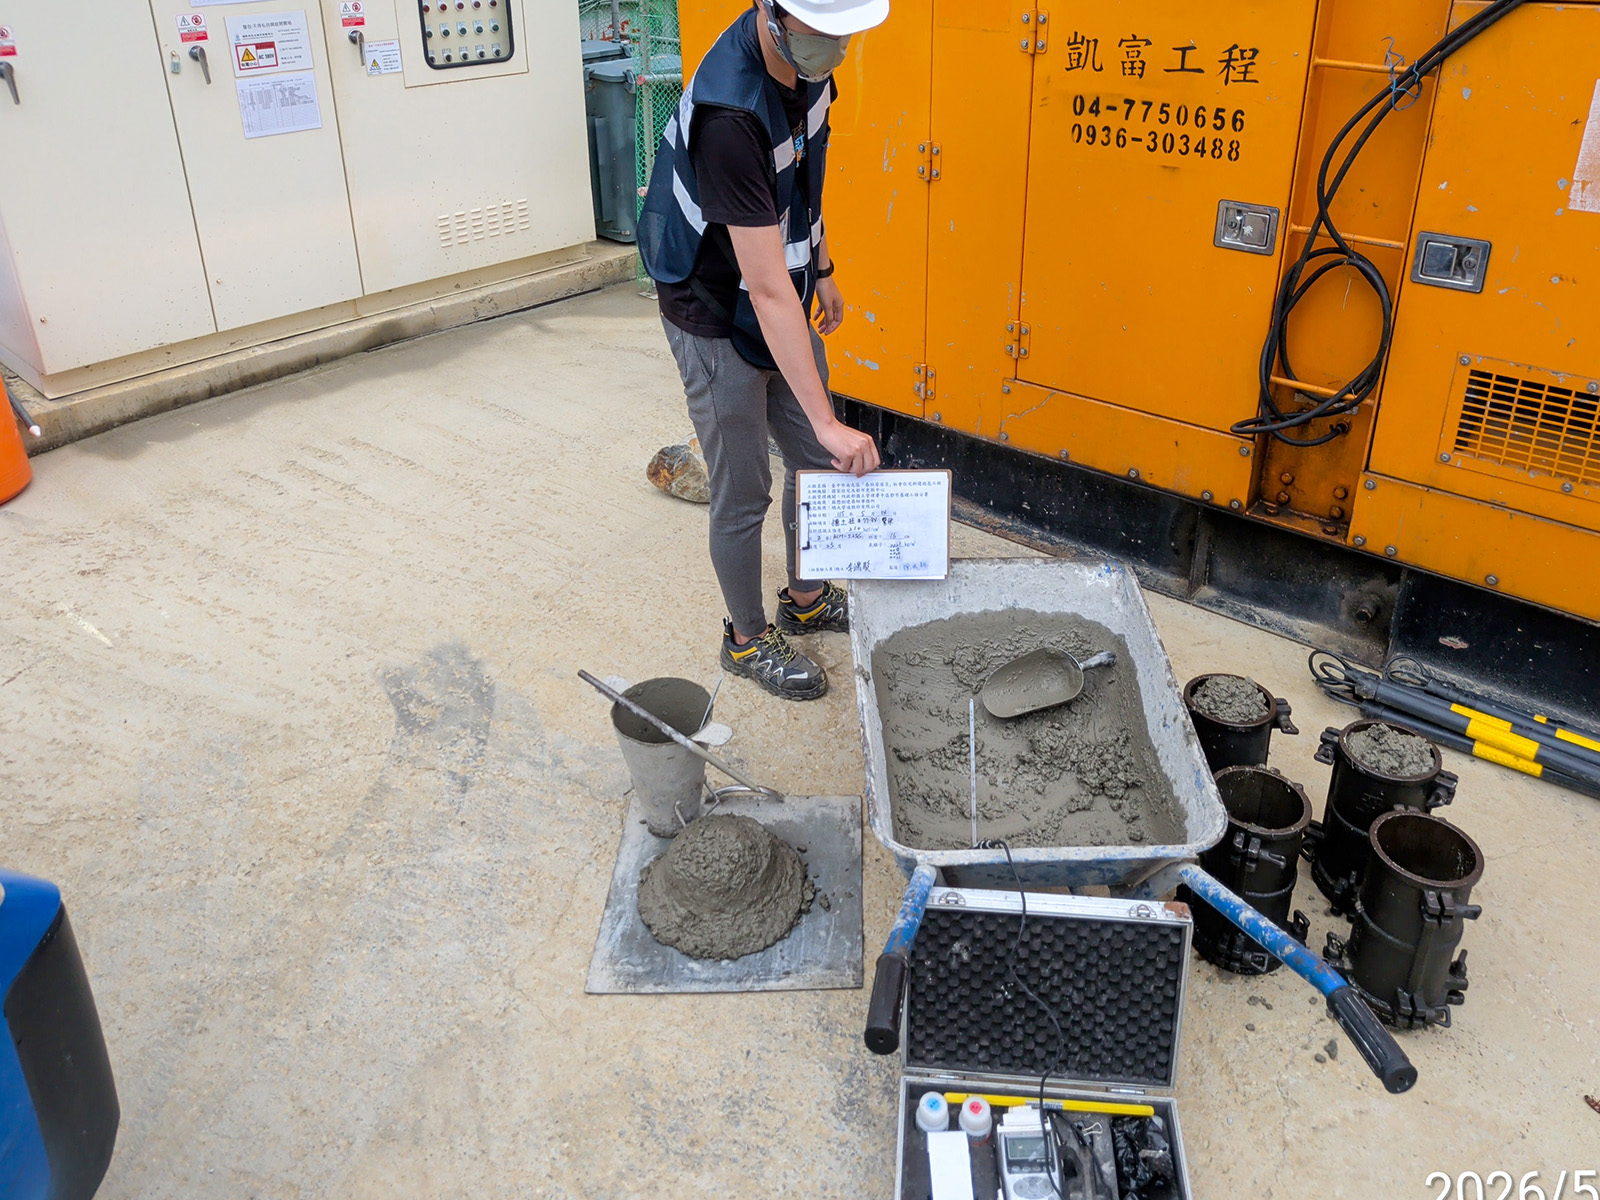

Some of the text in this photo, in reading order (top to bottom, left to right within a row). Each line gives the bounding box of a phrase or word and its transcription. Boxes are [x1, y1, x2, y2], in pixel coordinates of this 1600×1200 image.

[1064, 31, 1260, 87] 凱富工程
[1073, 94, 1245, 133] 04-7750656
[1071, 123, 1241, 162] 0936-303488
